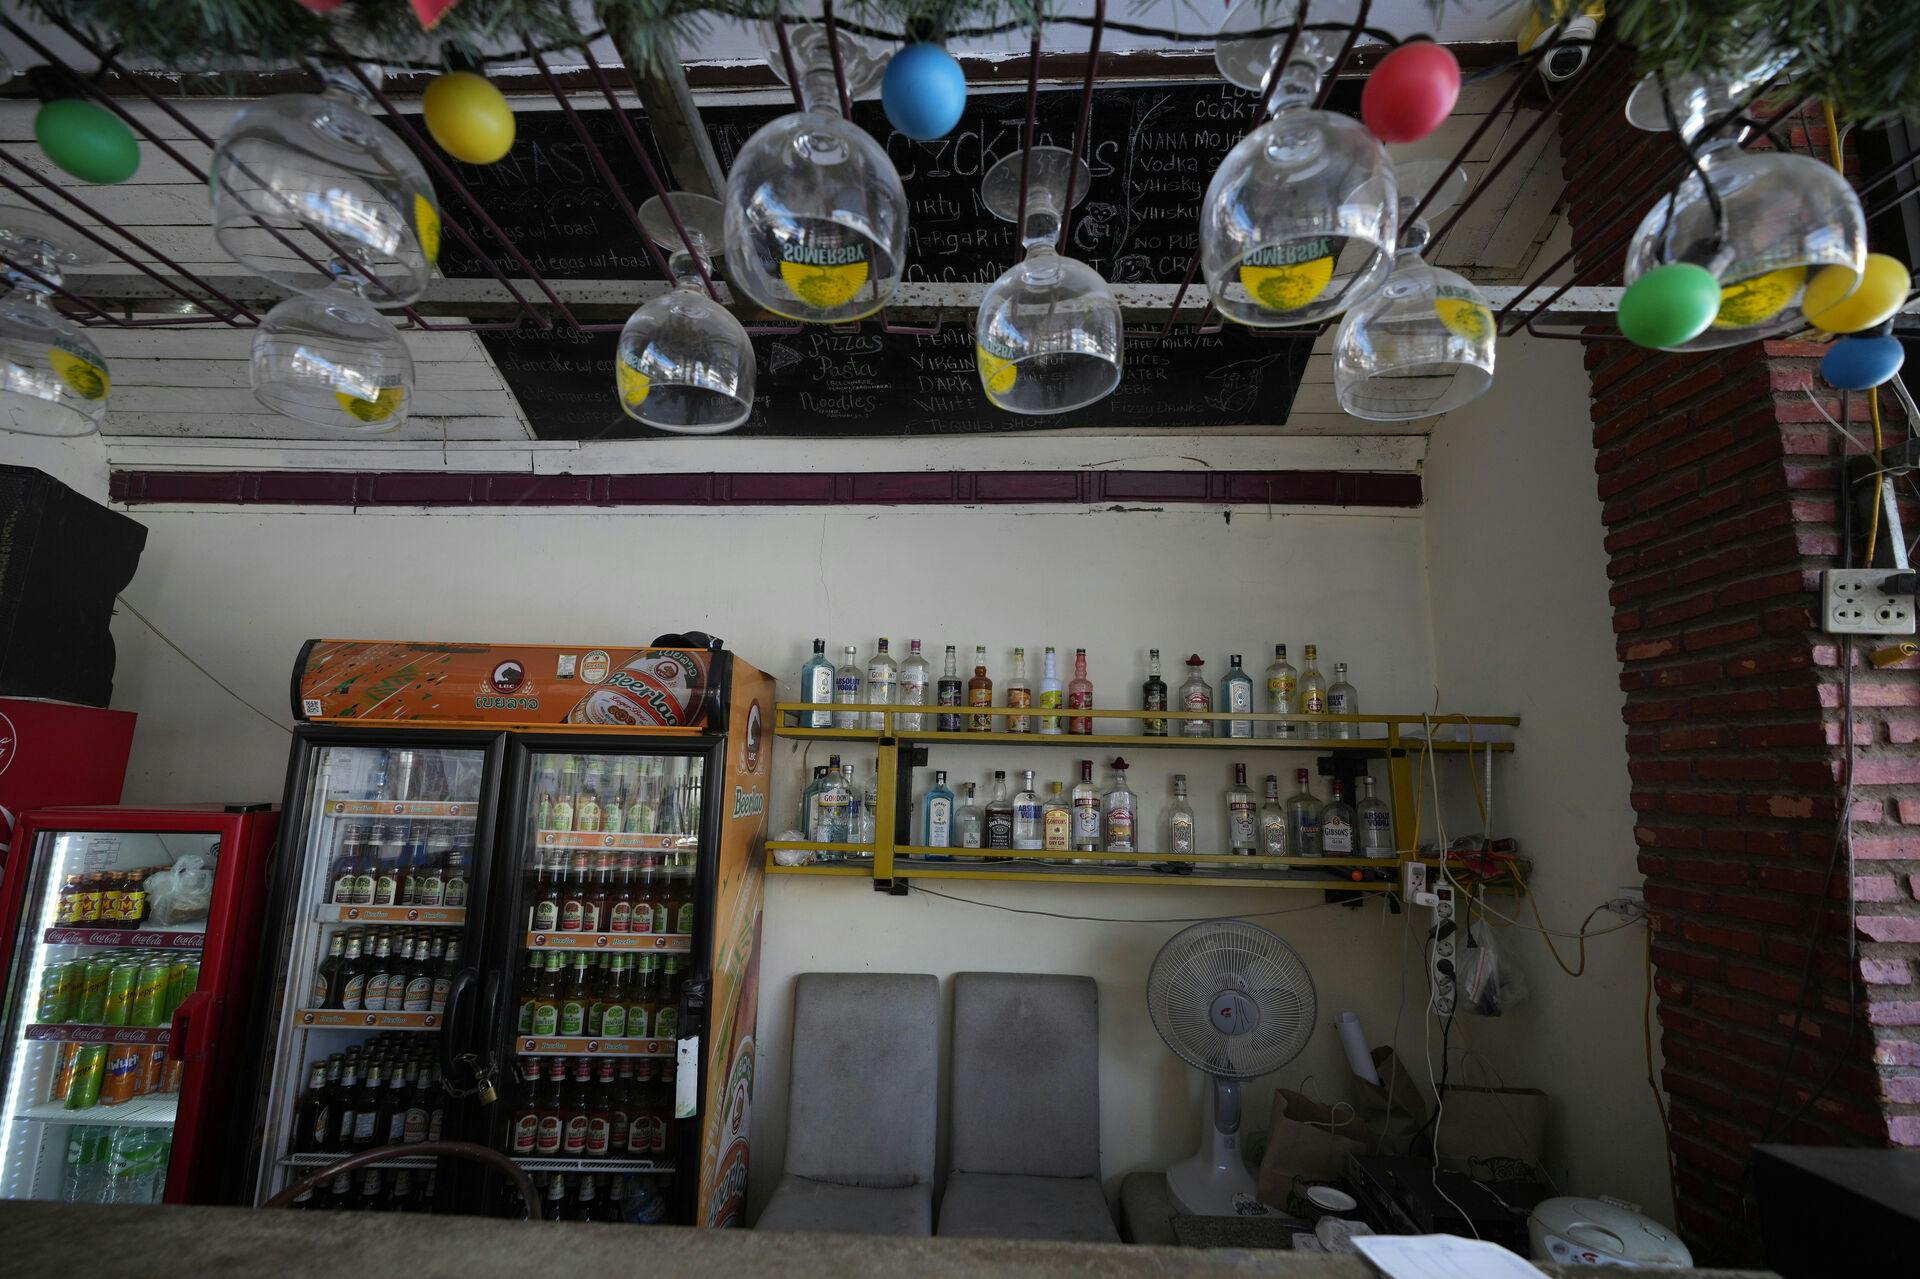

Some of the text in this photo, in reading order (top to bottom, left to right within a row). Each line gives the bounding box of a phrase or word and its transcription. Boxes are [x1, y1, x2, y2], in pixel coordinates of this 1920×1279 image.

[550, 215, 600, 236] toast
[808, 333, 884, 357] Pizzas
[812, 354, 879, 380] Pasta
[918, 375, 973, 393] DARK
[799, 391, 877, 412] Noodles
